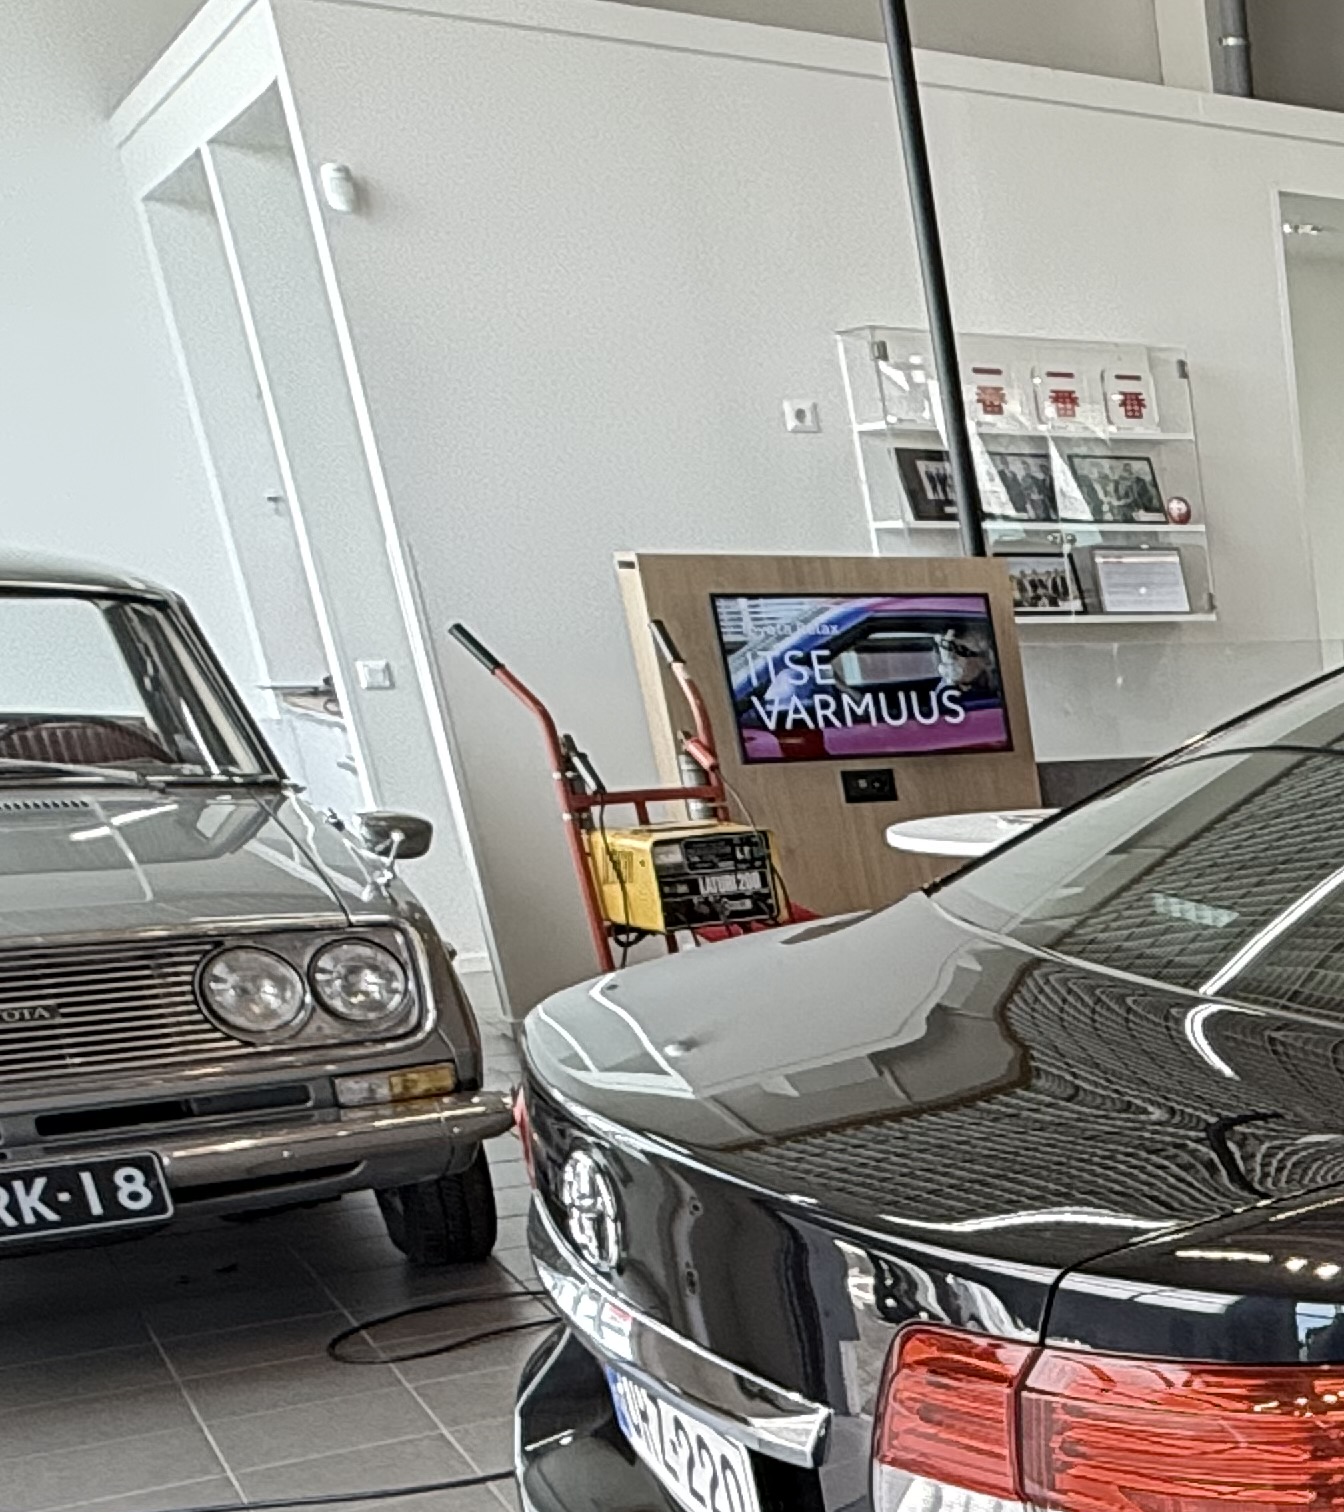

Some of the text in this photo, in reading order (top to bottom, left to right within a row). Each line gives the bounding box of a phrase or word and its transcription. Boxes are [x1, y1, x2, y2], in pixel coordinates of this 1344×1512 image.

[746, 648, 836, 687] ITSE
[750, 689, 966, 730] VARMUUS
[0, 1007, 50, 1022] OTA
